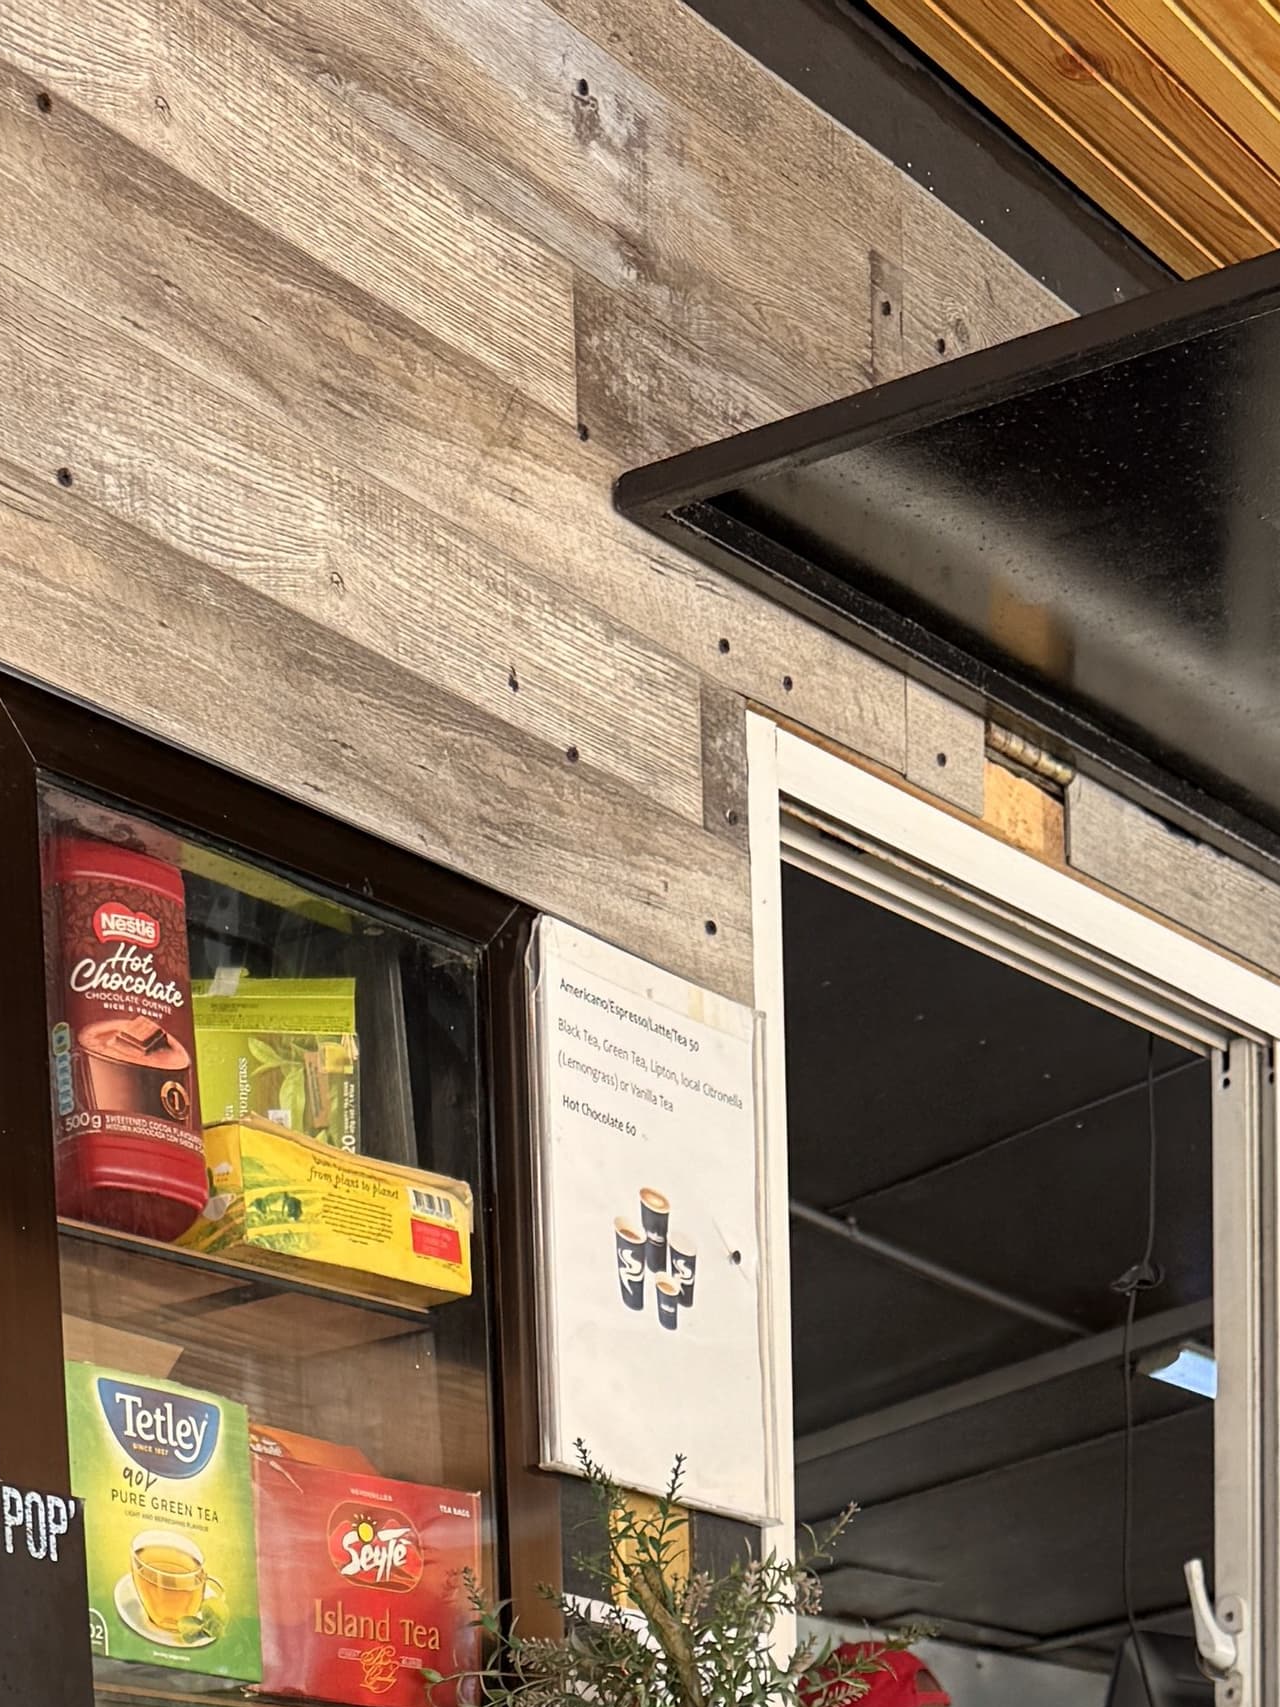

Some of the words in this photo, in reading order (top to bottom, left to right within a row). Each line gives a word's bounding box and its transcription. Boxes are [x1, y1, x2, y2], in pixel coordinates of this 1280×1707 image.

[106, 942, 153, 974] Hot
[70, 958, 184, 1007] Chocolate
[85, 991, 139, 1005] CHOCOLATE
[142, 998, 172, 1015] QUENTE
[558, 1018, 581, 1039] Black
[583, 1029, 601, 1051] Tea,
[602, 1038, 629, 1061] Green
[631, 1050, 648, 1072] Tea,
[650, 1059, 680, 1086] Lipton,
[681, 1073, 701, 1092] local
[702, 1083, 743, 1110] Citronella
[689, 1039, 700, 1053] 50
[238, 1057, 252, 1117] ongrass
[558, 1049, 618, 1092] (Lemongrass)
[620, 1080, 629, 1092] or
[630, 1083, 657, 1106] Vanilla
[659, 1095, 674, 1112] Tea
[562, 1095, 580, 1113] Hot
[581, 1103, 624, 1132] Chocolate
[625, 1122, 637, 1137] 60
[307, 1166, 332, 1183] from
[333, 1173, 360, 1190] plant
[361, 1179, 372, 1193] to
[115, 1392, 208, 1463] Tetley
[111, 1487, 147, 1508] PURE
[150, 1496, 193, 1518] GREEN
[196, 1506, 220, 1524] TEA
[439, 1504, 452, 1515] TEA
[453, 1507, 471, 1518] BAGS
[314, 1598, 391, 1643] Island
[400, 1618, 441, 1650] Tea
